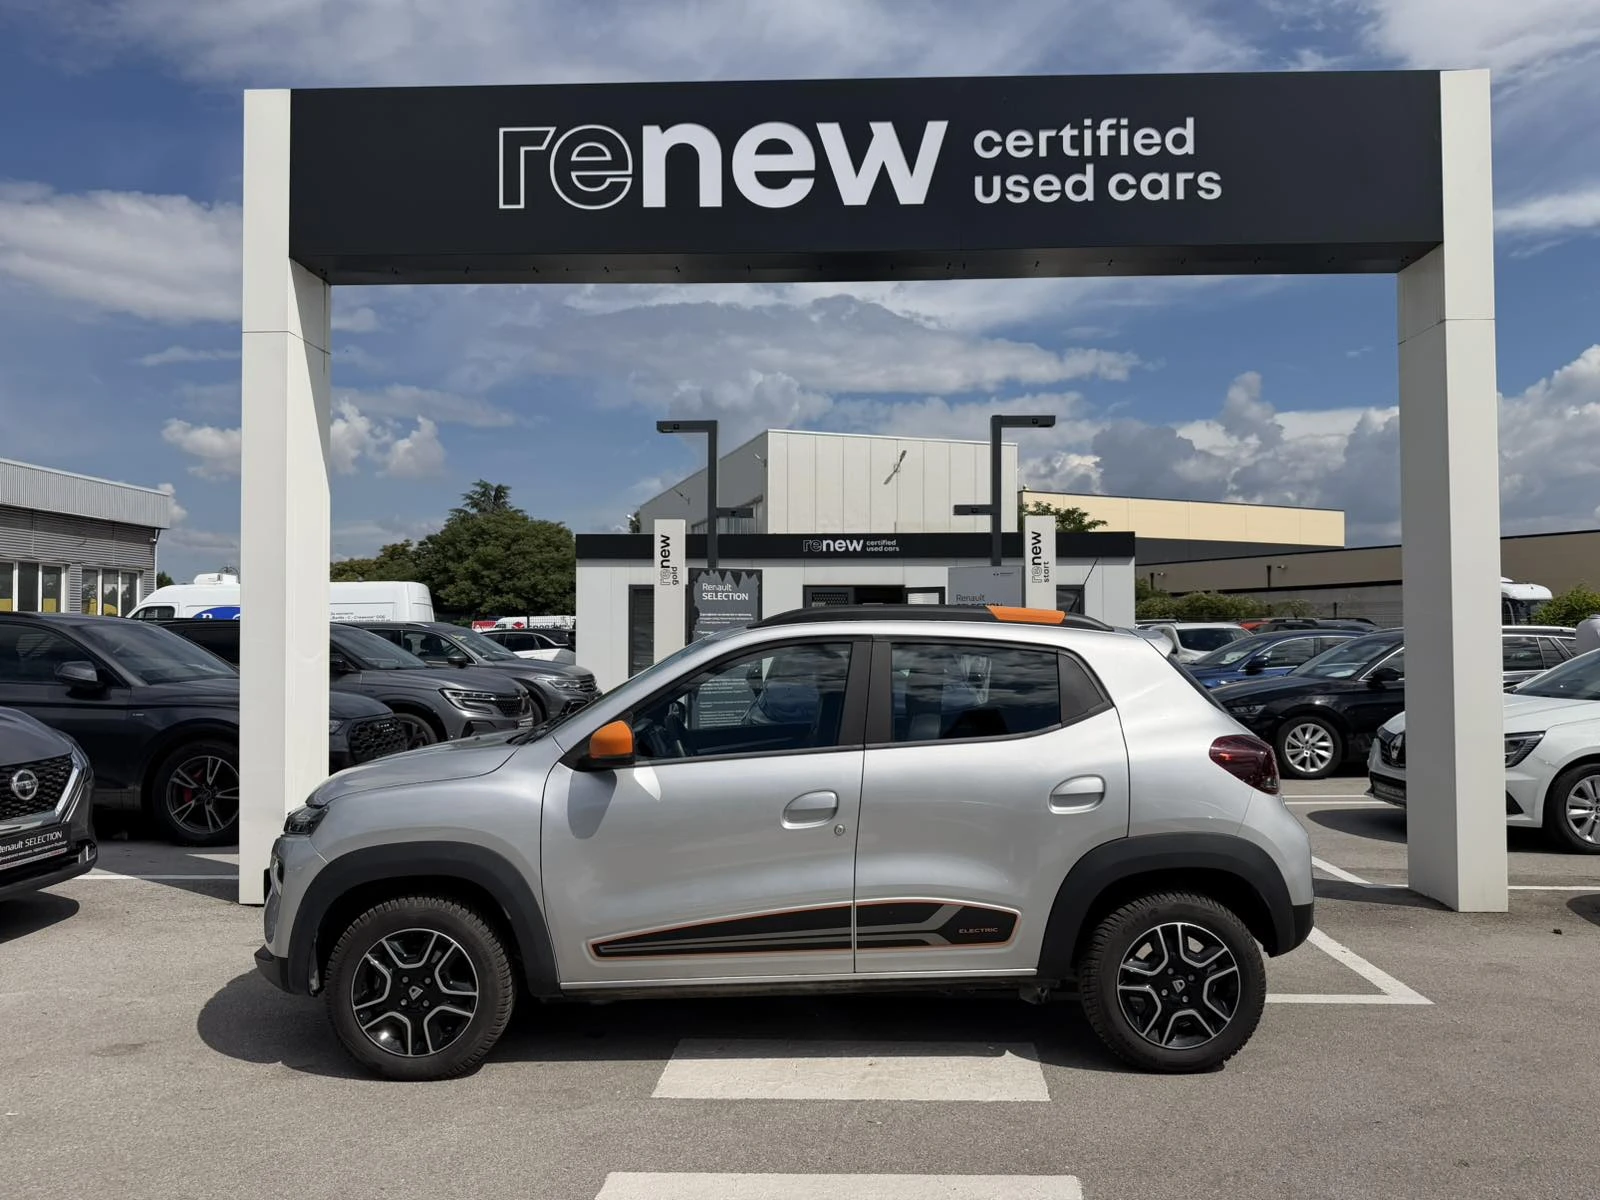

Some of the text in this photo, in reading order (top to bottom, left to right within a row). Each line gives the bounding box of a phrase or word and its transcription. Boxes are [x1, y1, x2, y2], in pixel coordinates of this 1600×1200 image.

[973, 116, 1196, 159] certified
[498, 119, 949, 211] renew
[973, 163, 1223, 205] used cars
[660, 534, 671, 586] renew
[802, 539, 864, 552] renew
[1031, 530, 1042, 584] renew
[671, 566, 680, 586] gold
[702, 582, 732, 592] Renault
[702, 592, 749, 601] SELECTION
[24, 830, 64, 848] SELECTION
